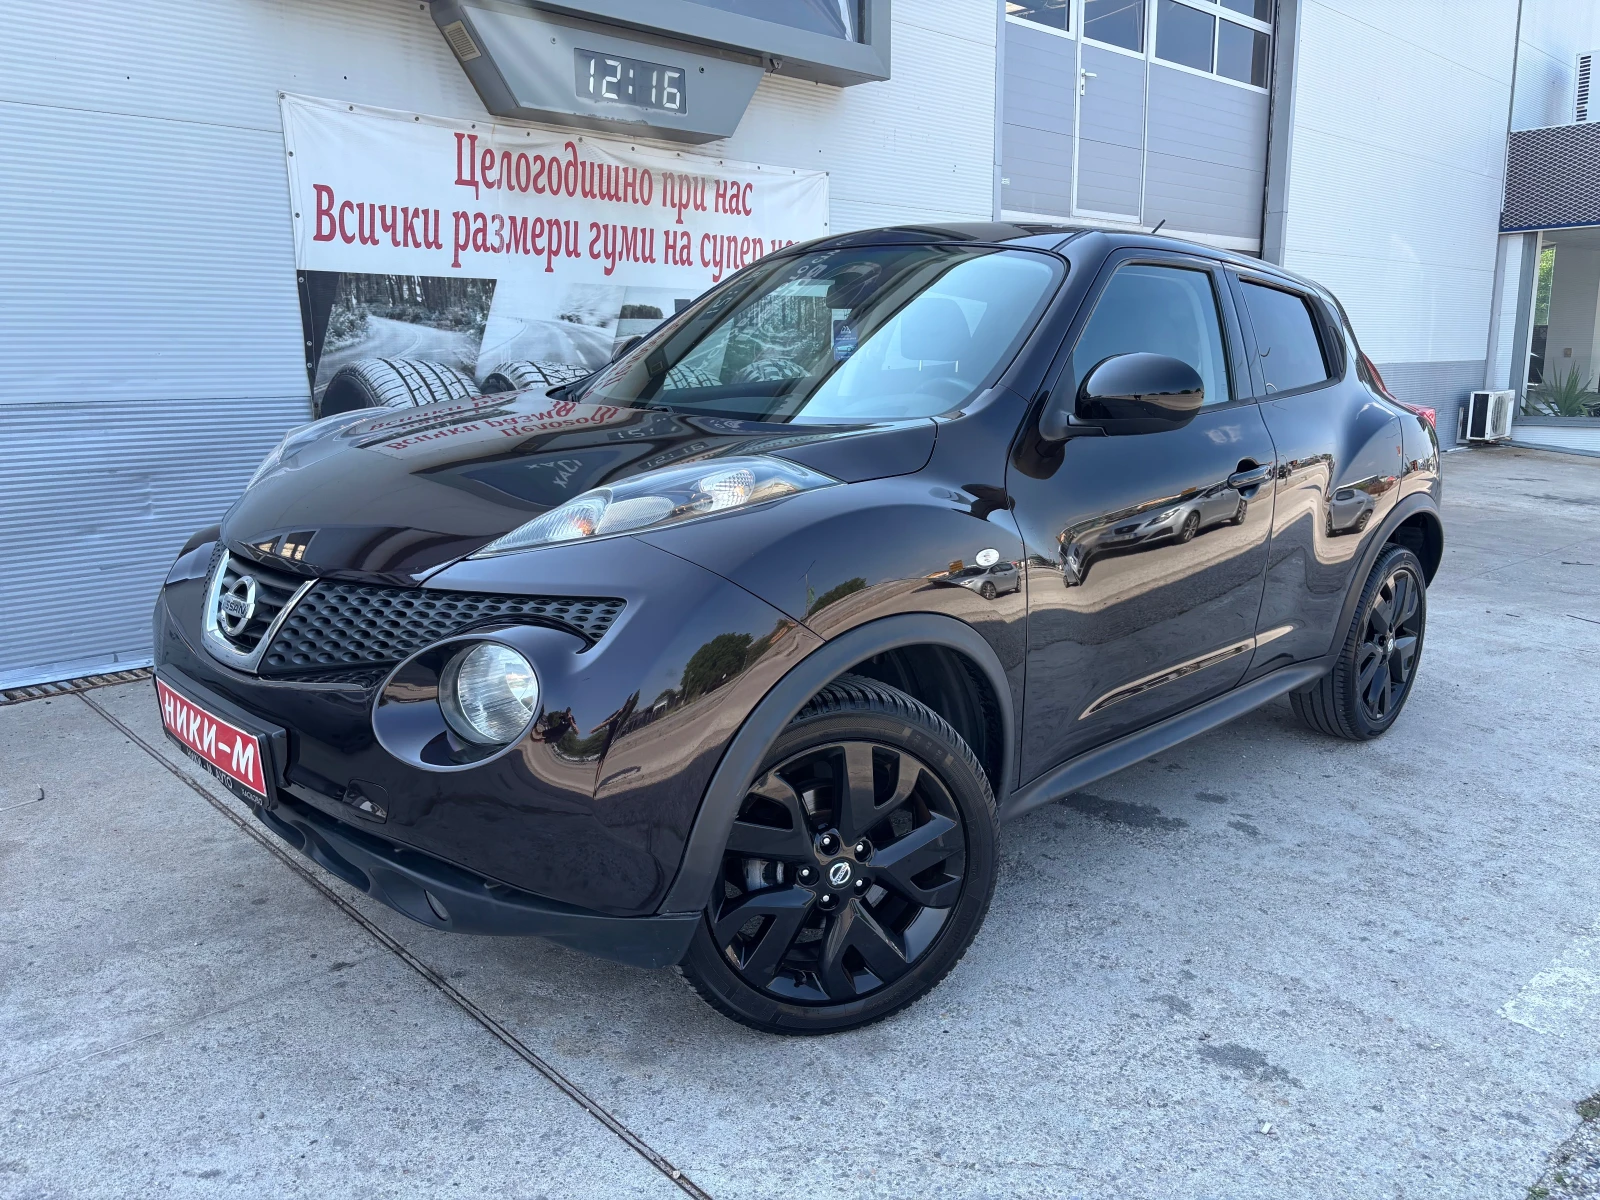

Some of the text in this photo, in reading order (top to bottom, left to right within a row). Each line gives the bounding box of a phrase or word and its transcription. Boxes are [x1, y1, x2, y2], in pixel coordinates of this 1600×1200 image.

[588, 58, 681, 110] 12:16
[454, 132, 754, 224] Целогодишно при нас
[313, 183, 442, 249] Всички
[452, 209, 582, 272] размери
[589, 220, 657, 276] гуми
[663, 229, 693, 267] на
[164, 690, 255, 783] НИКИ-М
